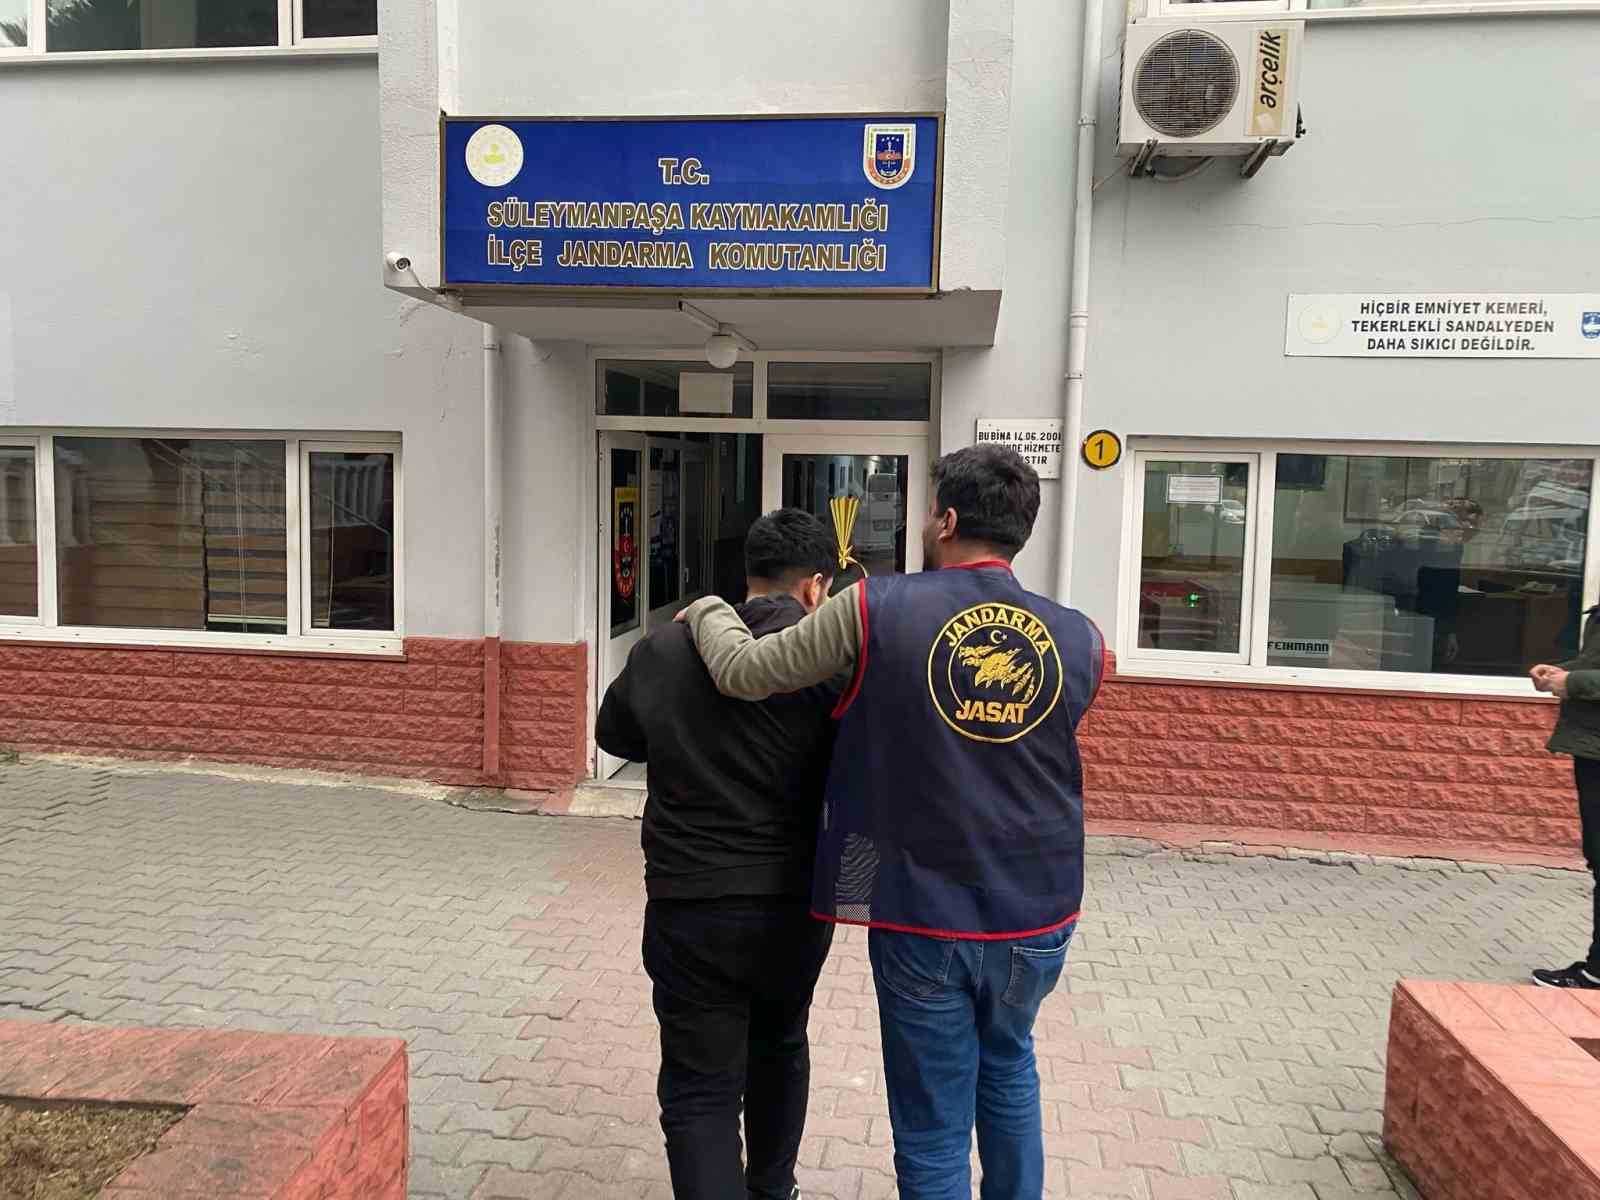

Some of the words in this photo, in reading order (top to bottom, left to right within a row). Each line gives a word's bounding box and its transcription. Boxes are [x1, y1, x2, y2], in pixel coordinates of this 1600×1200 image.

[1260, 31, 1282, 109] arçelik
[658, 158, 710, 185] T.C.
[486, 198, 683, 235] SÜLEYMANPAŞA
[691, 199, 888, 232] KAYMAKAMLIĞI
[487, 238, 542, 270] İLÇE
[557, 242, 693, 269] JANDARMA
[708, 240, 887, 272] KOMUTANLIĞI
[1360, 300, 1410, 316] HİÇBİR
[1415, 300, 1480, 314] EMNİYET
[1485, 300, 1548, 316] KEMERİ,
[1352, 318, 1441, 333] TEKERLEKLİ
[1446, 321, 1554, 333] SANDALYEDEN
[1367, 338, 1406, 350] DAHA
[1411, 338, 1456, 350] SIKICI
[1460, 336, 1536, 351] DEĞİLDİR.
[978, 432, 989, 441] BU
[990, 429, 1011, 441] BİNA
[1024, 441, 1061, 453] HİZMETE
[1094, 439, 1103, 460] 1
[944, 607, 1052, 657] JANDARMA
[955, 700, 1029, 724] JASAT
